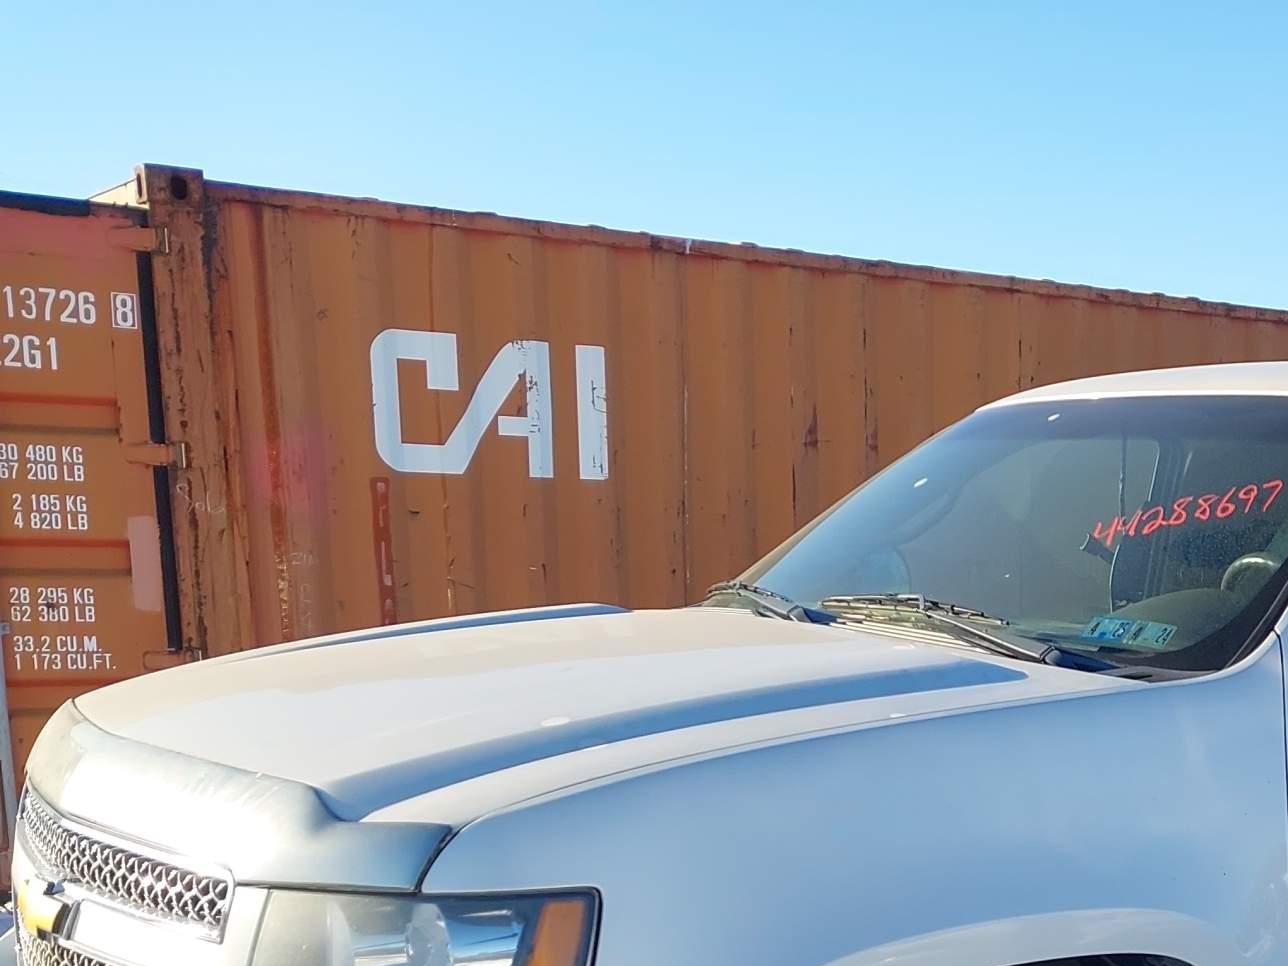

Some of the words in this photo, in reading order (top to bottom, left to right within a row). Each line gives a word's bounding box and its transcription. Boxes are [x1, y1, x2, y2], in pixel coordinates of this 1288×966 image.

[2, 285, 97, 325] 13726
[115, 294, 133, 327] 8
[0, 334, 58, 370] 2G1
[370, 328, 608, 480] CAI
[25, 444, 57, 462] 480
[61, 446, 83, 463] KG
[0, 462, 19, 480] 67
[26, 463, 58, 481] 200
[63, 464, 85, 482] LB
[12, 493, 22, 510] 2
[31, 494, 60, 511] 185
[65, 495, 87, 512] KG
[14, 511, 24, 528] 4
[30, 512, 61, 529] 820
[67, 513, 89, 530] LB
[1092, 479, 1284, 546] 44288697
[9, 587, 30, 604] 28
[37, 587, 67, 604] 295
[73, 588, 94, 605] KG
[10, 605, 31, 622] 62
[38, 605, 69, 622] 380
[74, 606, 96, 623] LB
[13, 635, 51, 652] 33.2
[56, 635, 103, 652] CU.M.
[14, 653, 21, 670] 1
[31, 653, 62, 670] 173
[67, 653, 117, 670] CU.FT.
